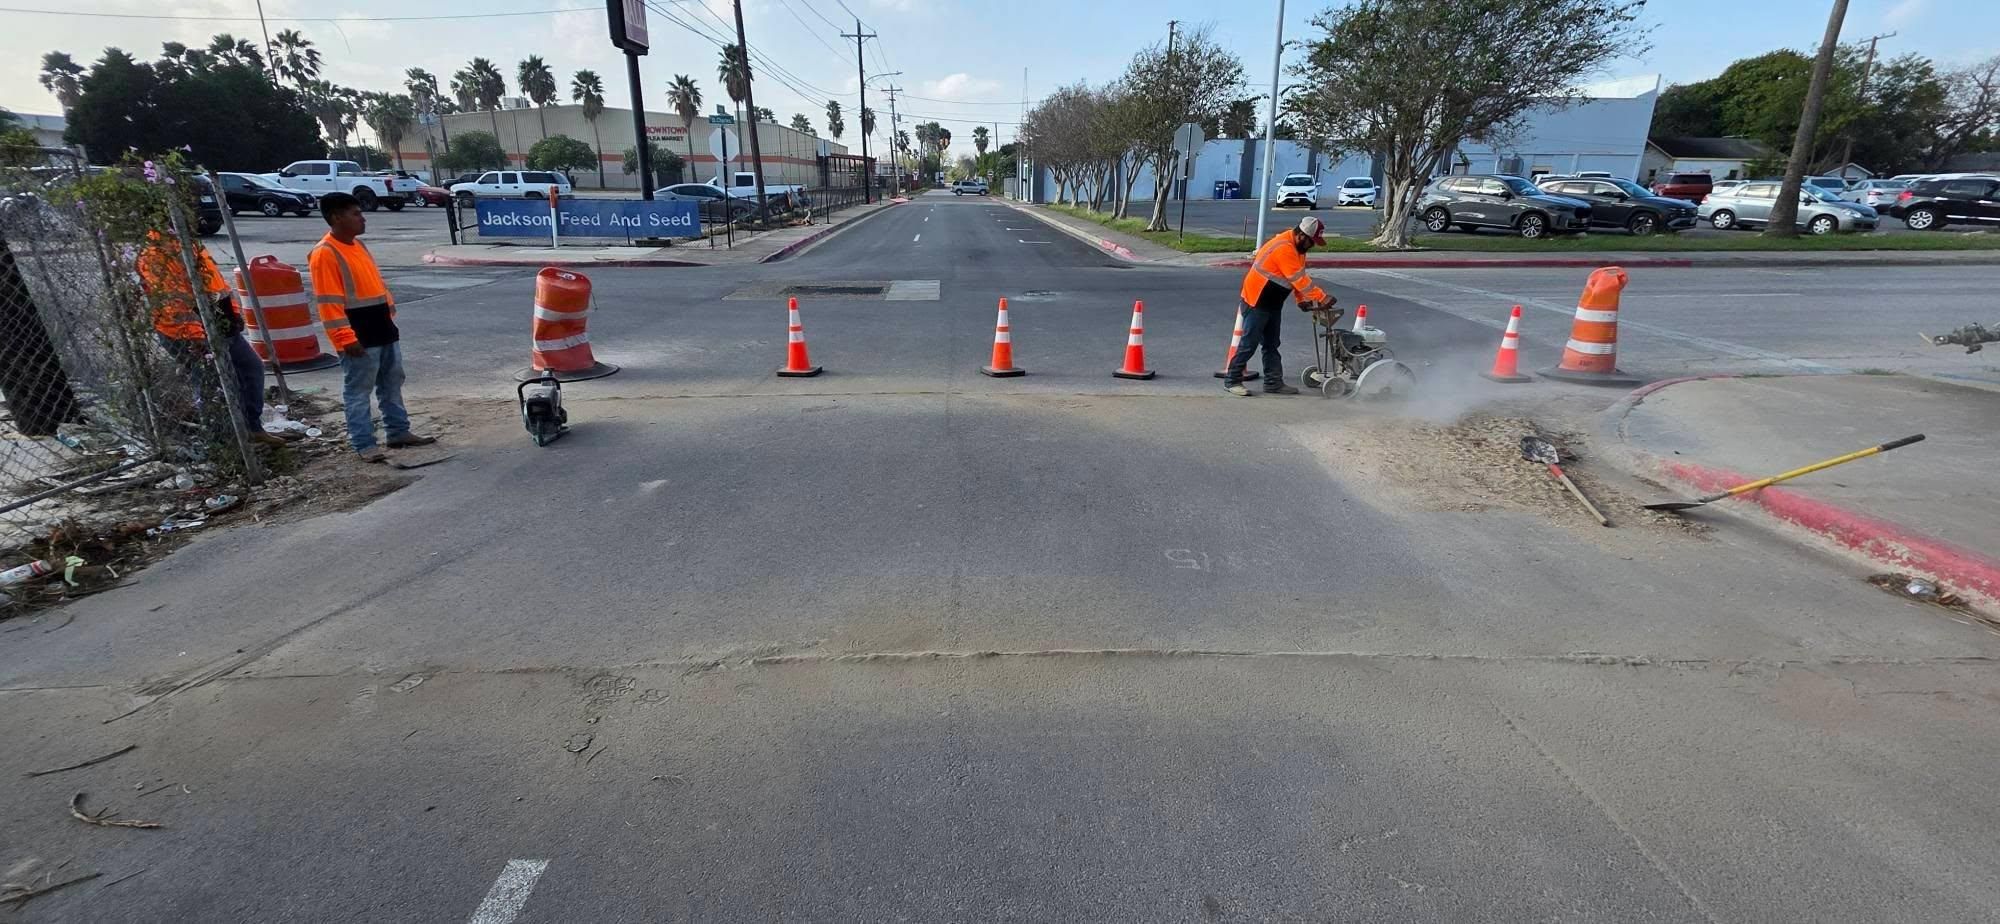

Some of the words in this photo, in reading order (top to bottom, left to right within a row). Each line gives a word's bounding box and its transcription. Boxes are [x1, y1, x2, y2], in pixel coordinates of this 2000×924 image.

[482, 212, 551, 226] Jackson
[560, 212, 600, 226] Feed
[609, 212, 641, 226] And
[650, 212, 692, 226] Seed
